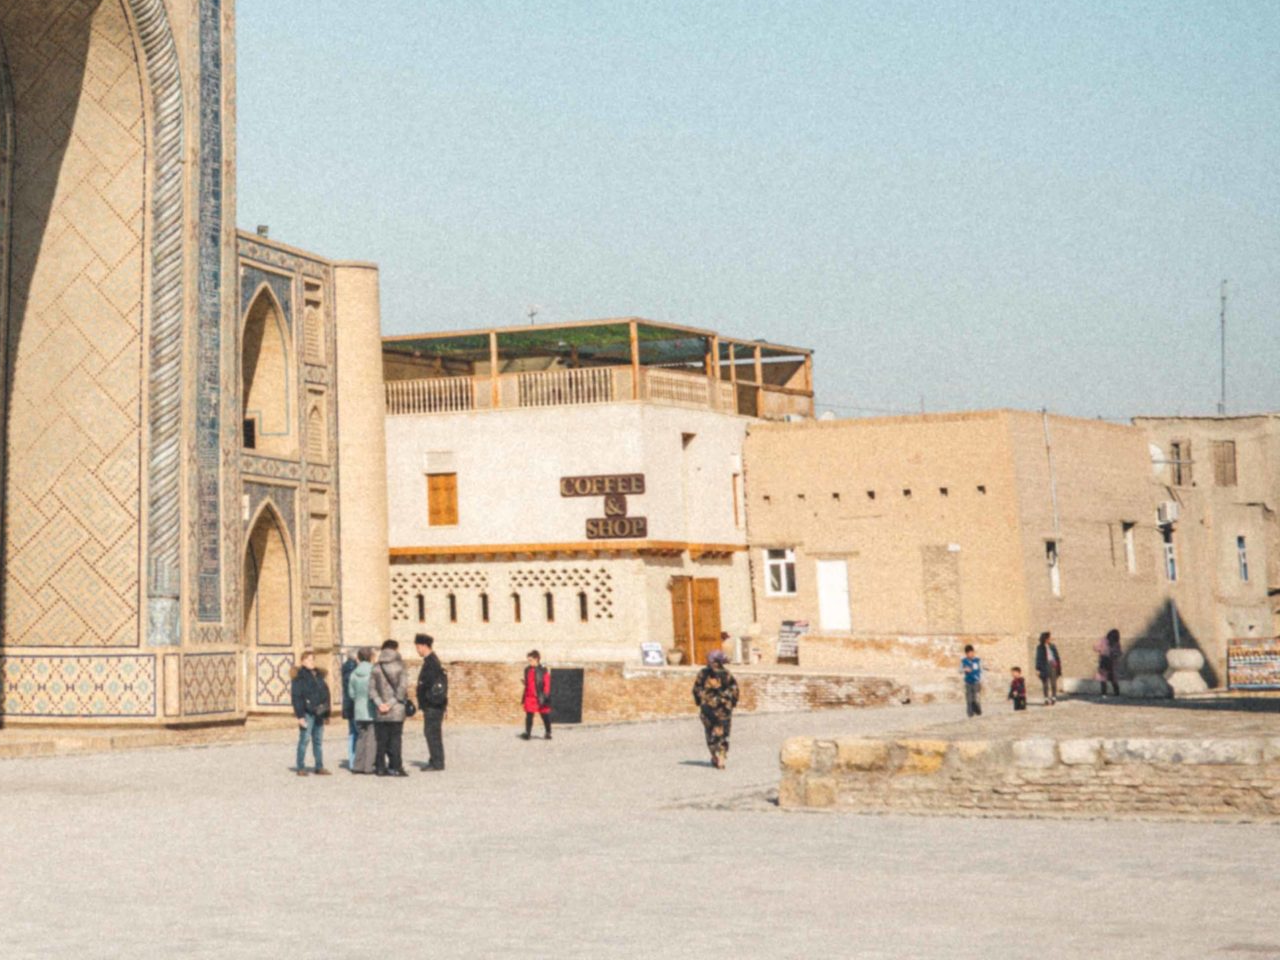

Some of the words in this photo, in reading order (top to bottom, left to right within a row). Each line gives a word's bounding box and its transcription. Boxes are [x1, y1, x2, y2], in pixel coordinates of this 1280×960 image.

[561, 477, 642, 495] COFFEE
[606, 498, 624, 515] &
[587, 520, 644, 537] SHOP
